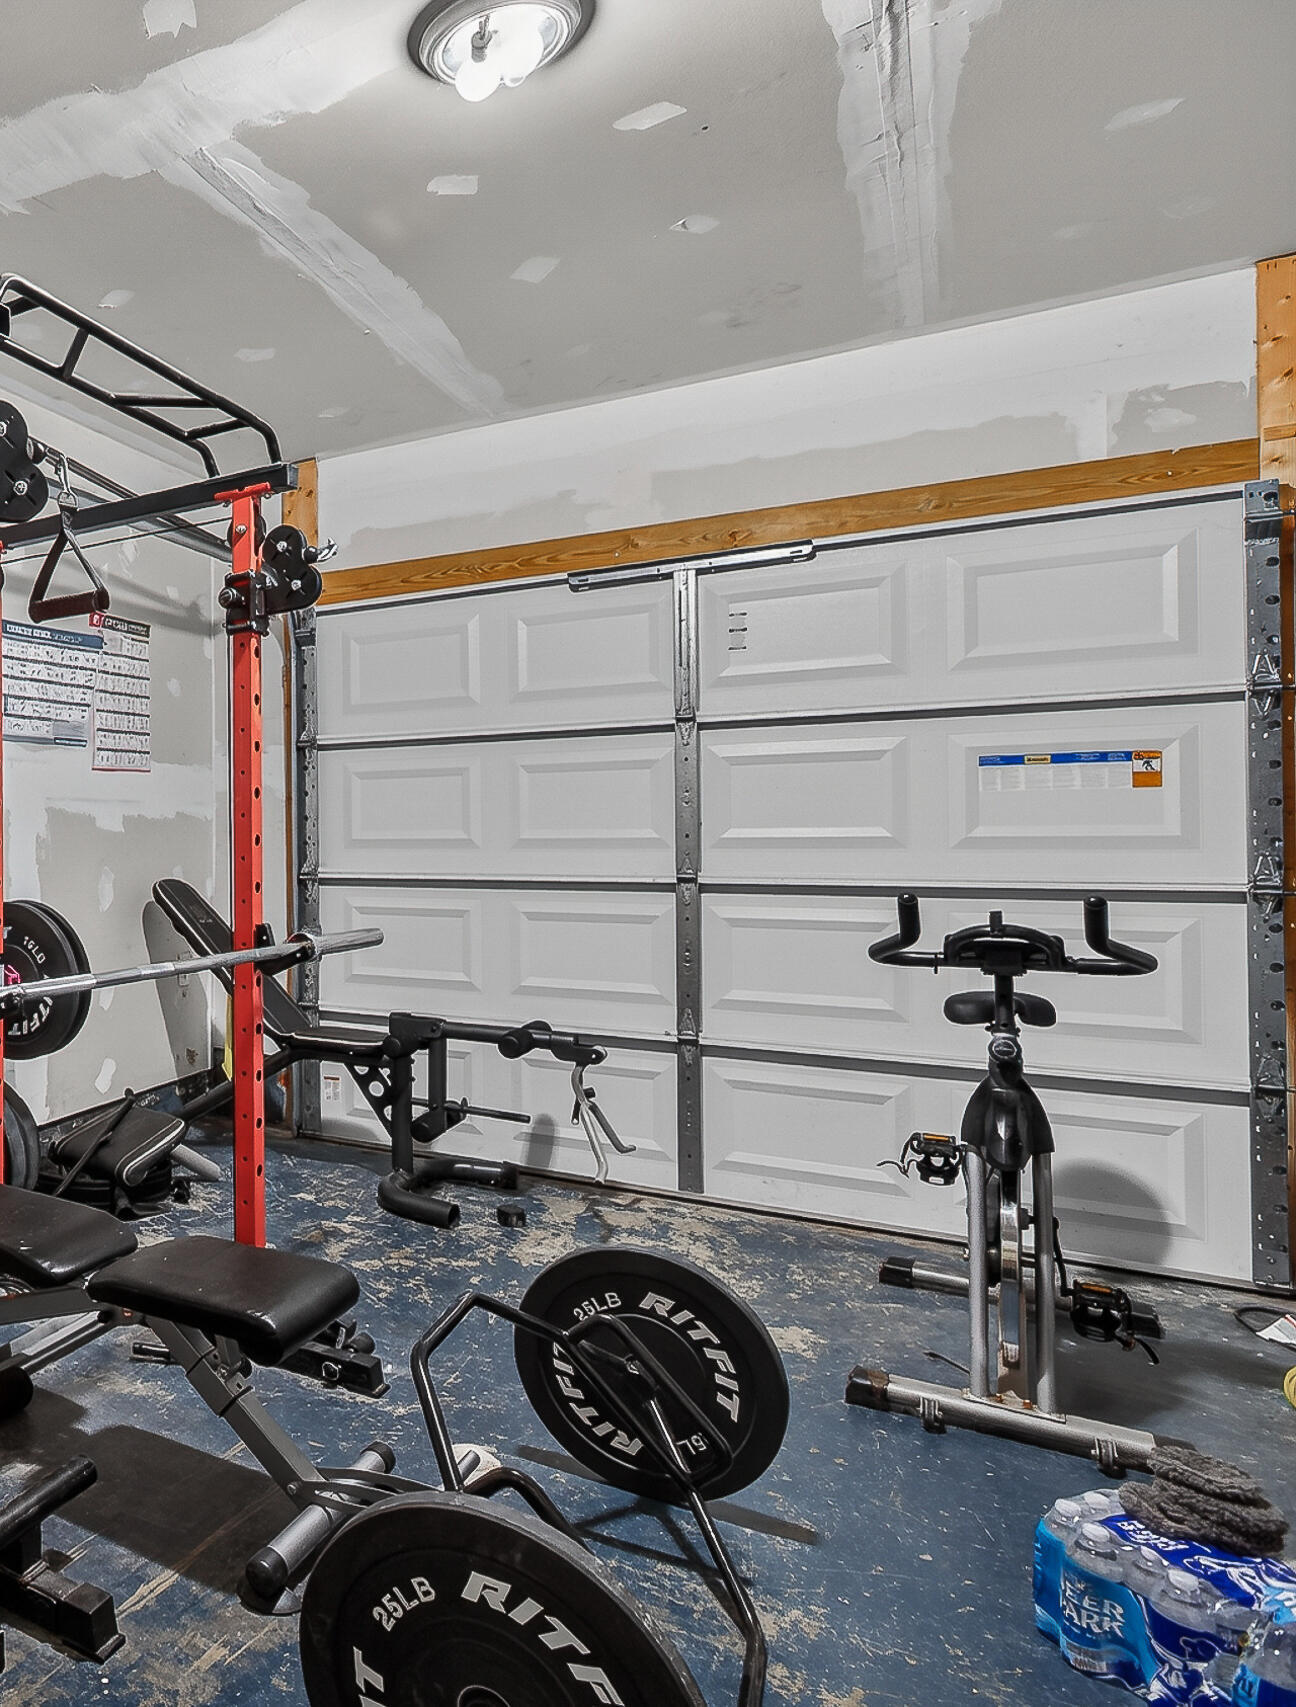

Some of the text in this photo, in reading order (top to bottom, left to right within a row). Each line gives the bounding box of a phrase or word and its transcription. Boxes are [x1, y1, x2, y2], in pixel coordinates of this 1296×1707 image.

[639, 1291, 739, 1423] RITFIT
[372, 1576, 436, 1632] 25LB
[1063, 1599, 1124, 1639] ARK
[1065, 1580, 1125, 1623] EER
[461, 1571, 625, 1707] RITF
